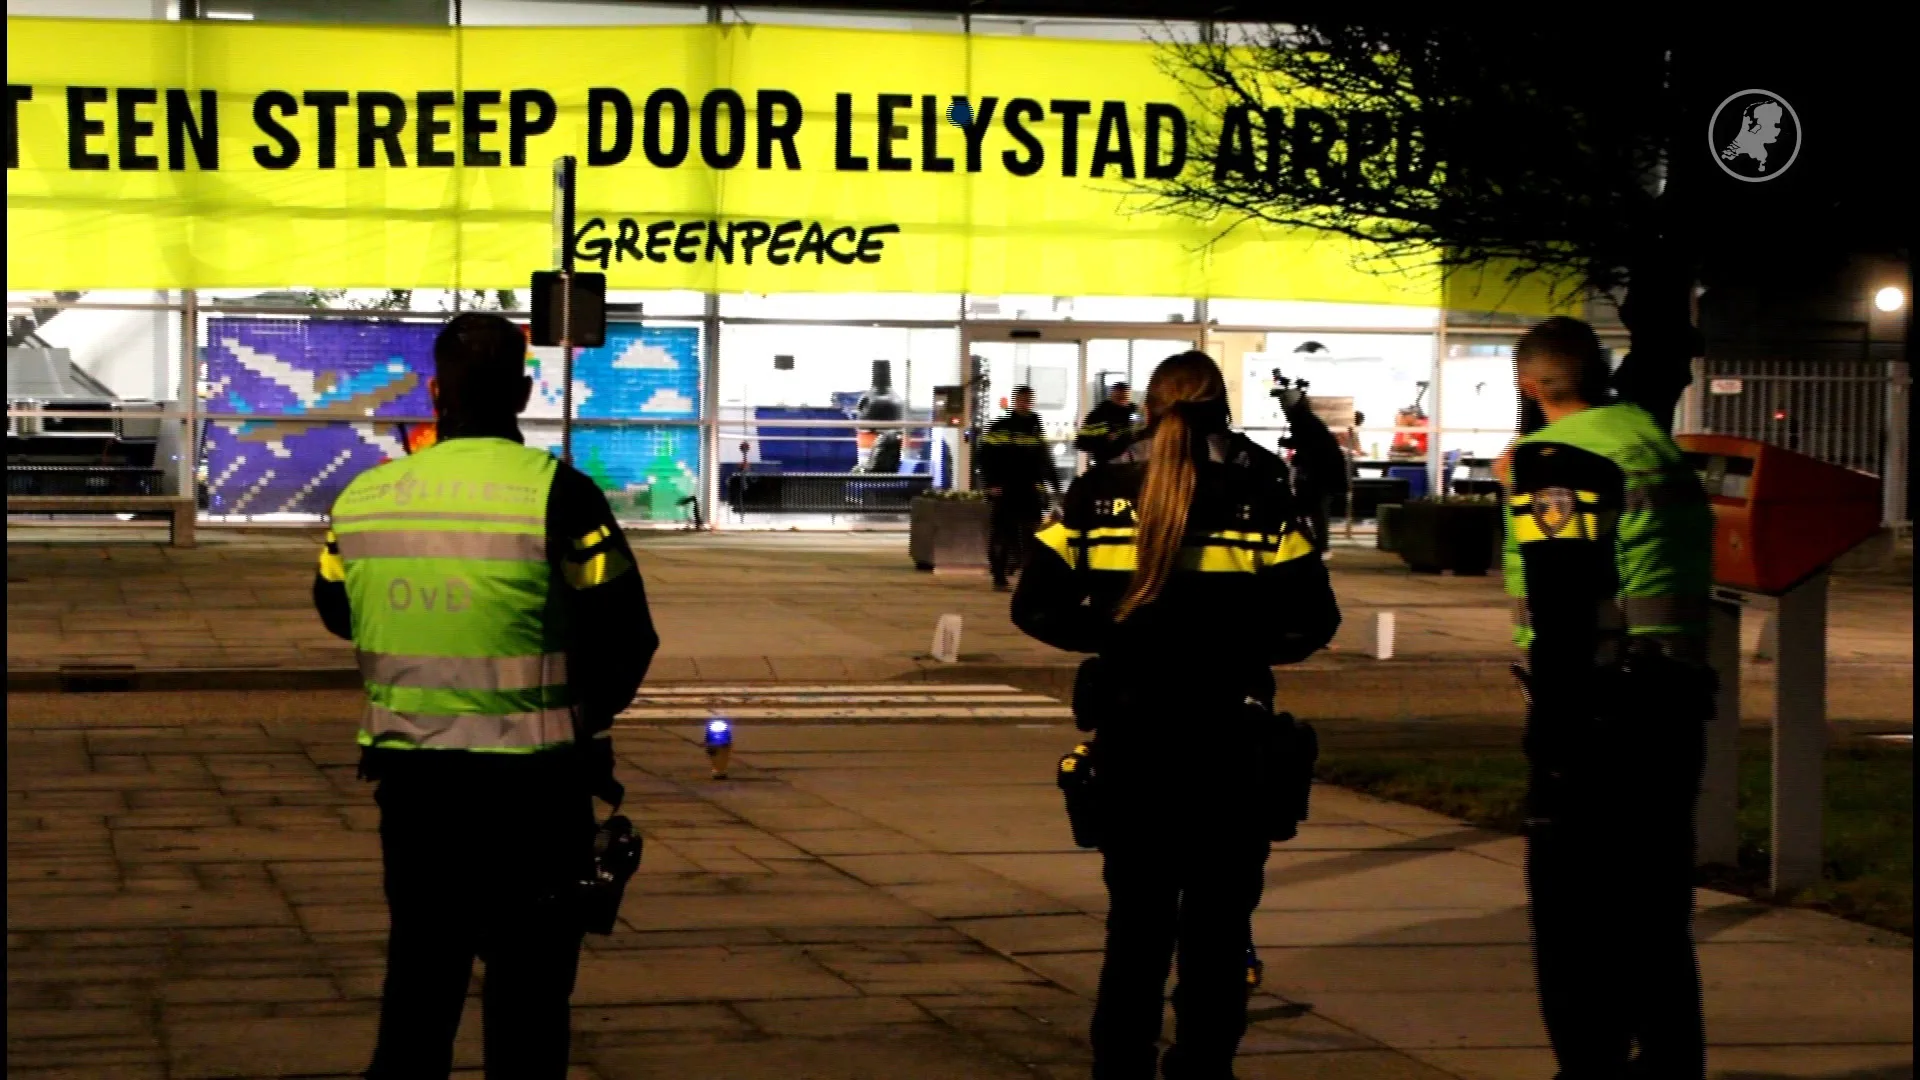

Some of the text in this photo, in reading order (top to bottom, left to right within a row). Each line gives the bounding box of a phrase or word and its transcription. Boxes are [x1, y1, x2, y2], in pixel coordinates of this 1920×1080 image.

[66, 86, 219, 171] EEN
[252, 89, 557, 169] STREEP
[587, 87, 803, 170] DOOR
[835, 93, 1190, 180] LELYSTAD
[574, 216, 900, 269] GREENPEACE
[388, 576, 473, 613] OvD
